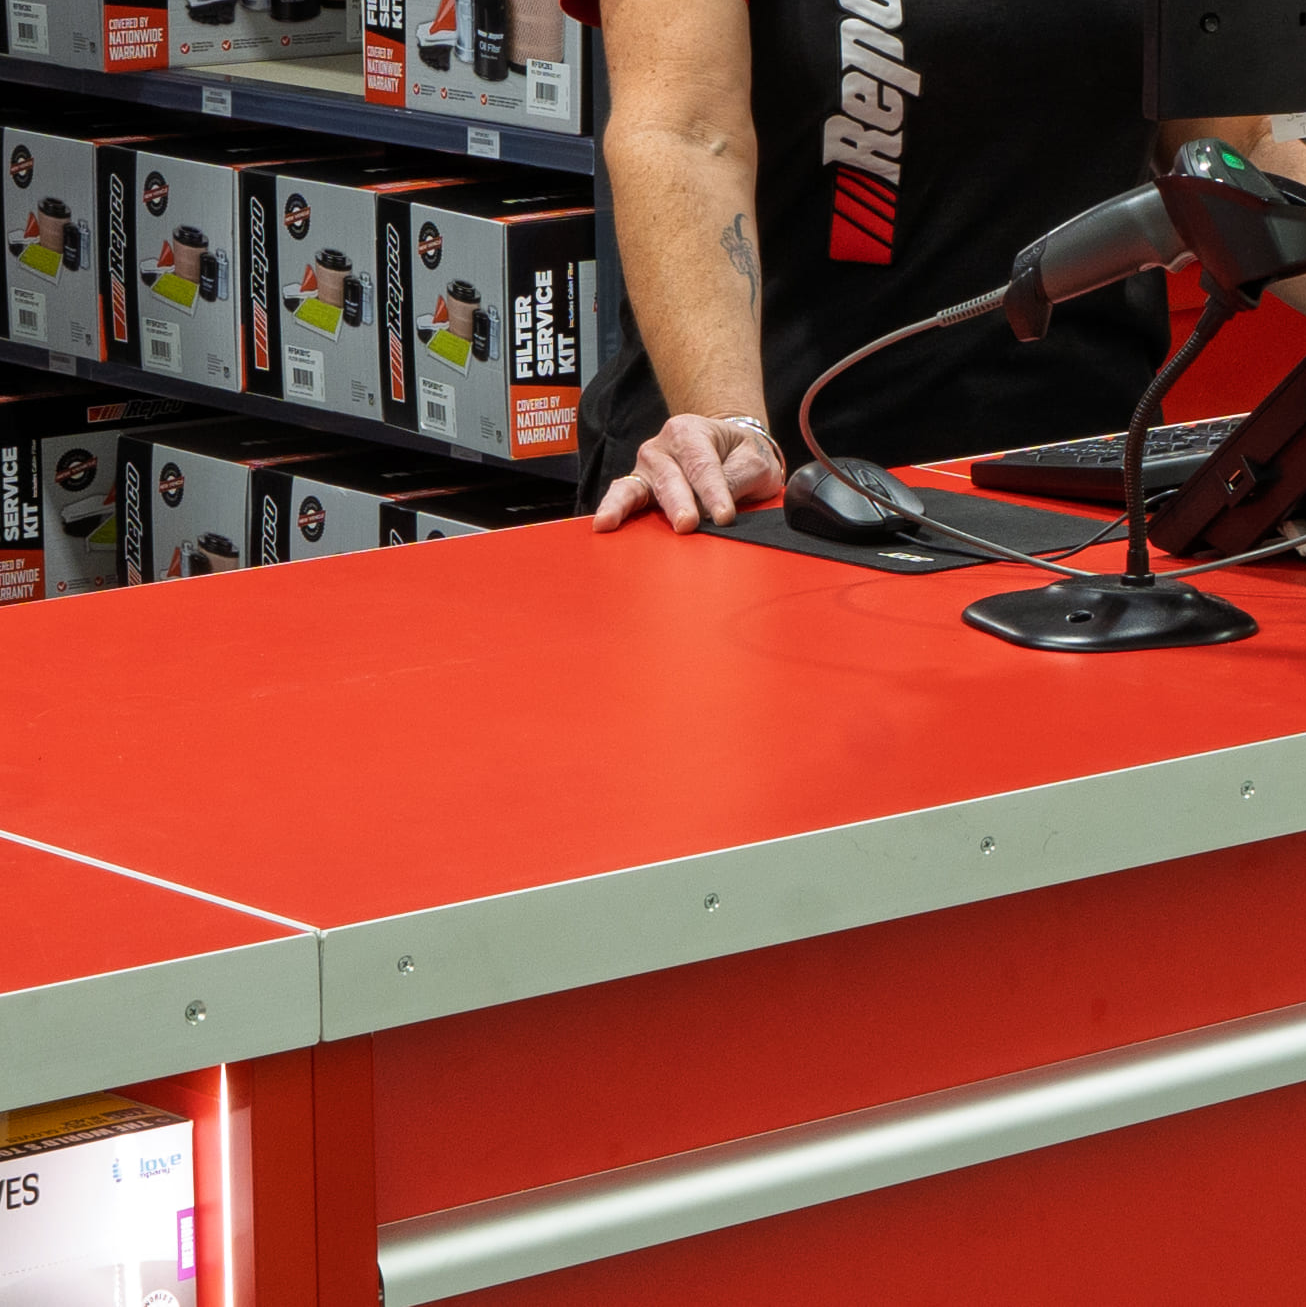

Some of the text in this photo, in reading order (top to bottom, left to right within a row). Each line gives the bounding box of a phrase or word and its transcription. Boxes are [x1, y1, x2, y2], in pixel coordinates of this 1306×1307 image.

[109, 173, 124, 271] Repco
[386, 223, 400, 331] Repco
[536, 271, 553, 377] SERVICE
[515, 296, 532, 379] FILTER
[558, 332, 576, 374] KIT
